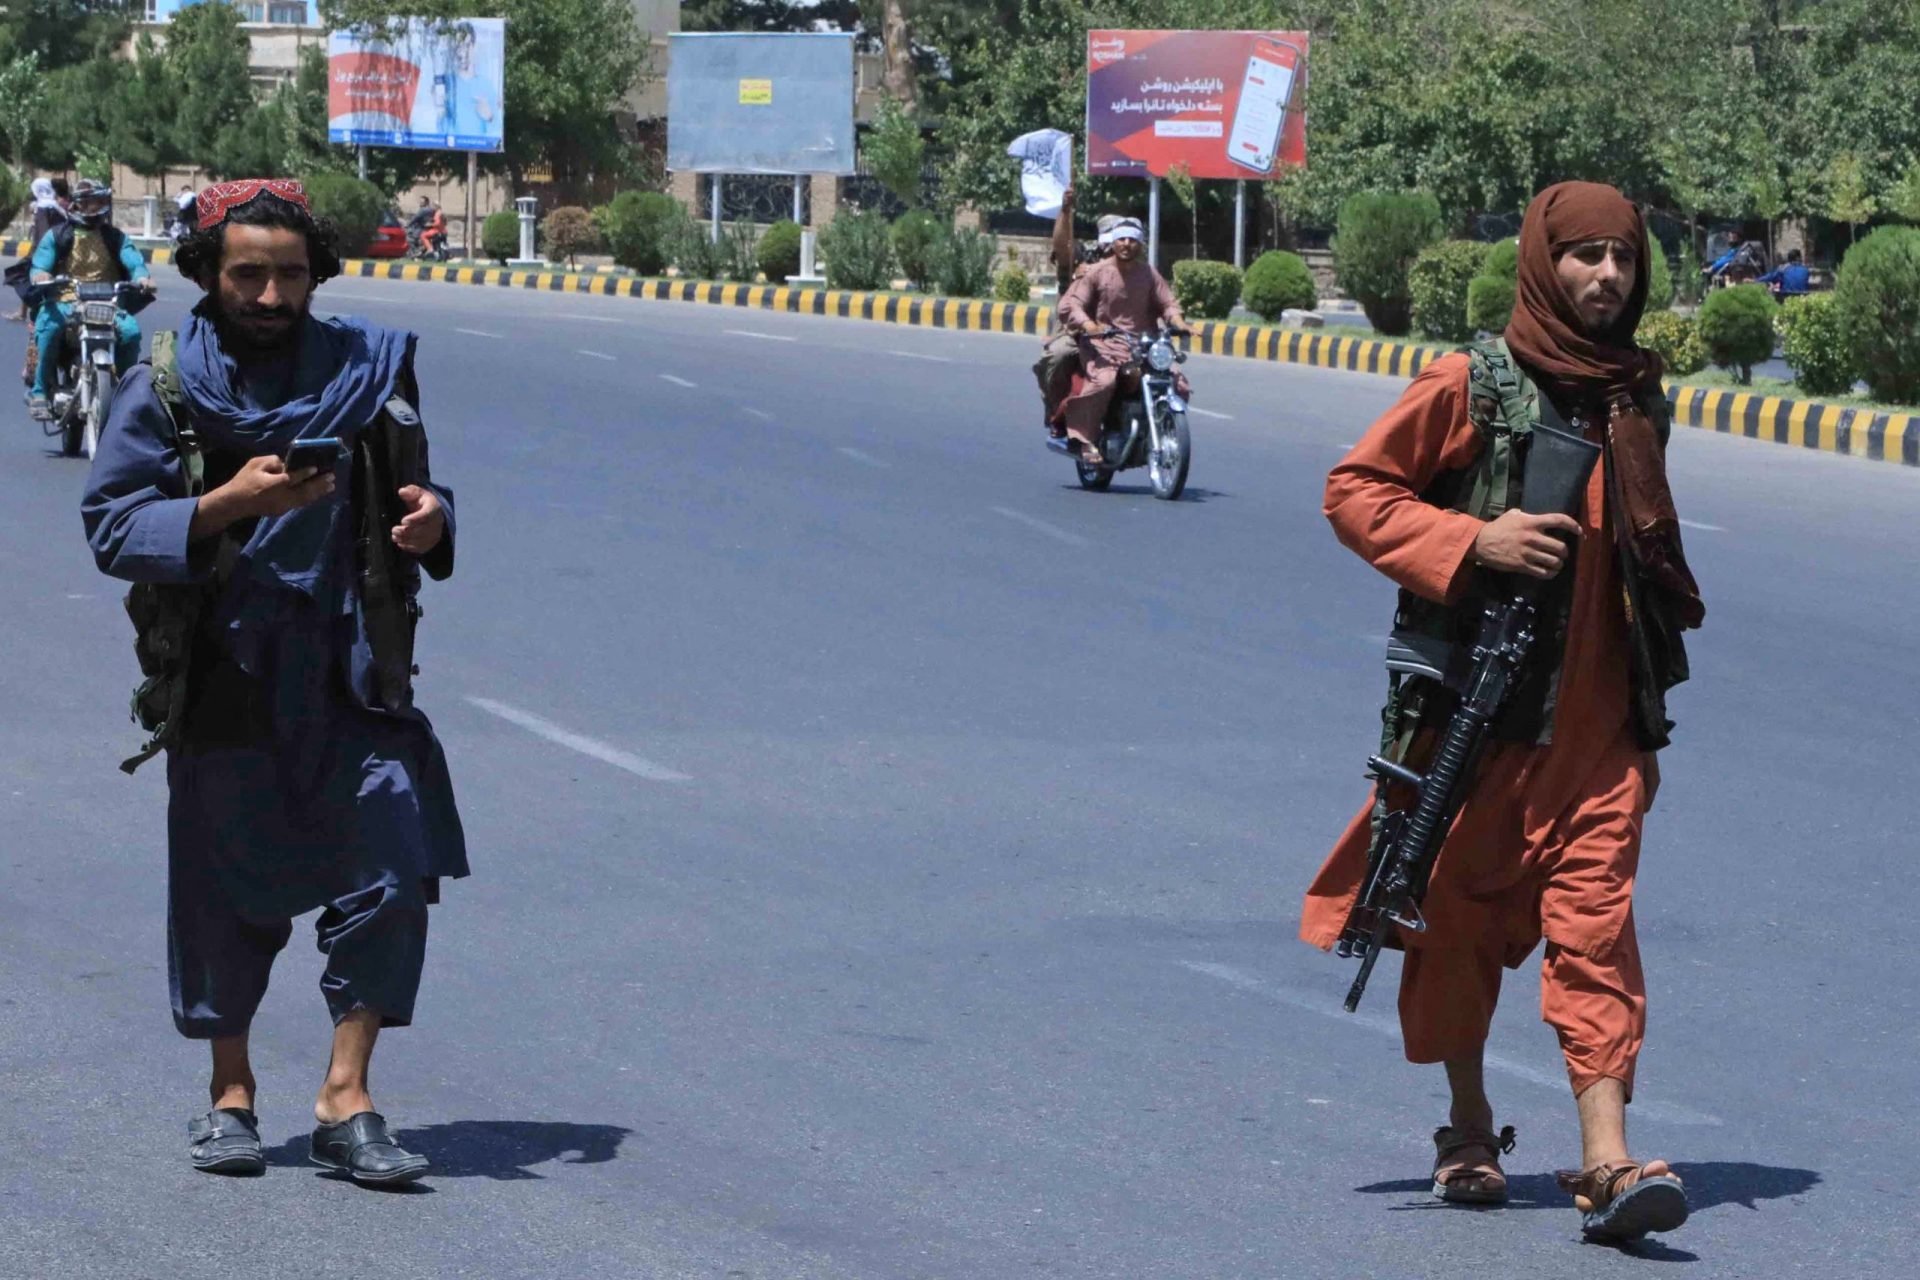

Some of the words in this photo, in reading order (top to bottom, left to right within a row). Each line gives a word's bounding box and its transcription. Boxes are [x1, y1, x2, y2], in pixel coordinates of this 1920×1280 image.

[1140, 76, 1172, 94] روشن
[1216, 77, 1224, 93] با
[1166, 98, 1196, 113] دلخواه
[1197, 99, 1224, 114] بسته
